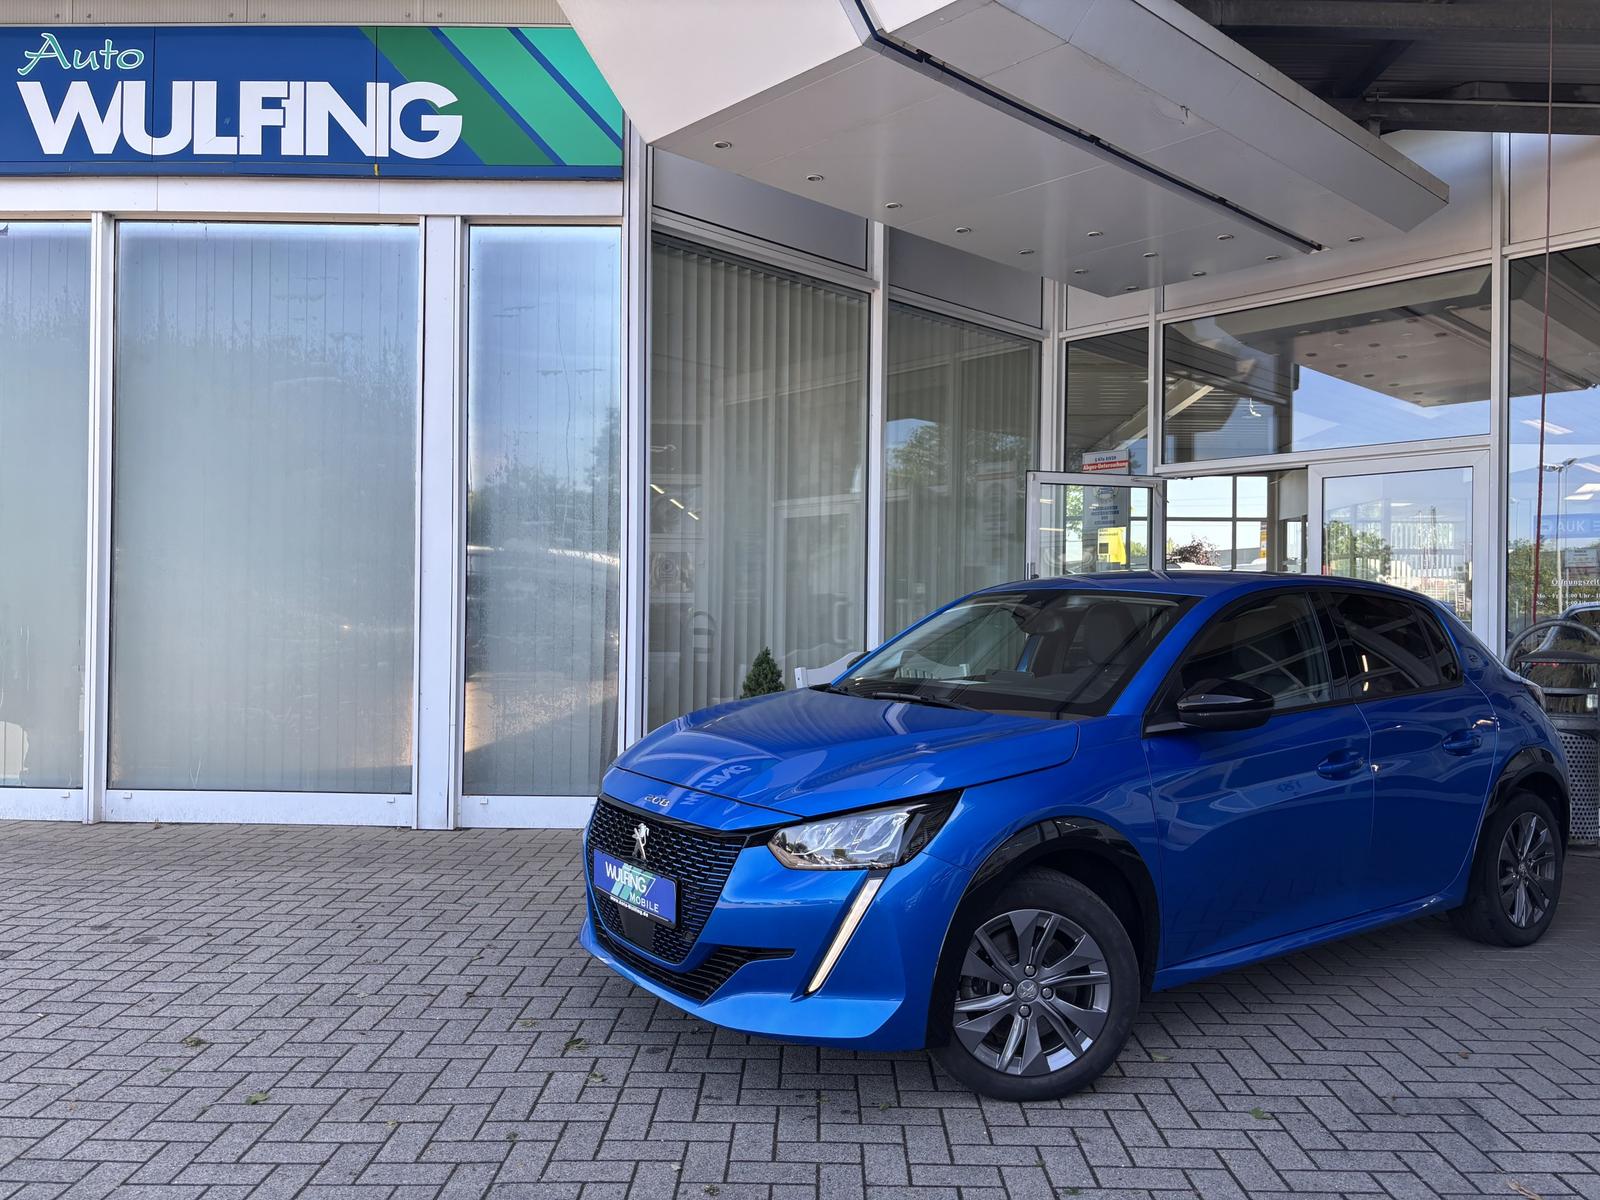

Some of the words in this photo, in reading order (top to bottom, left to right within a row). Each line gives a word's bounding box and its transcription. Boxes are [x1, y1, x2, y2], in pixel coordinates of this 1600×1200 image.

[17, 32, 145, 76] Auto
[16, 80, 463, 159] WULFING
[605, 861, 647, 893] WULFING
[629, 891, 660, 913] MOBILE
